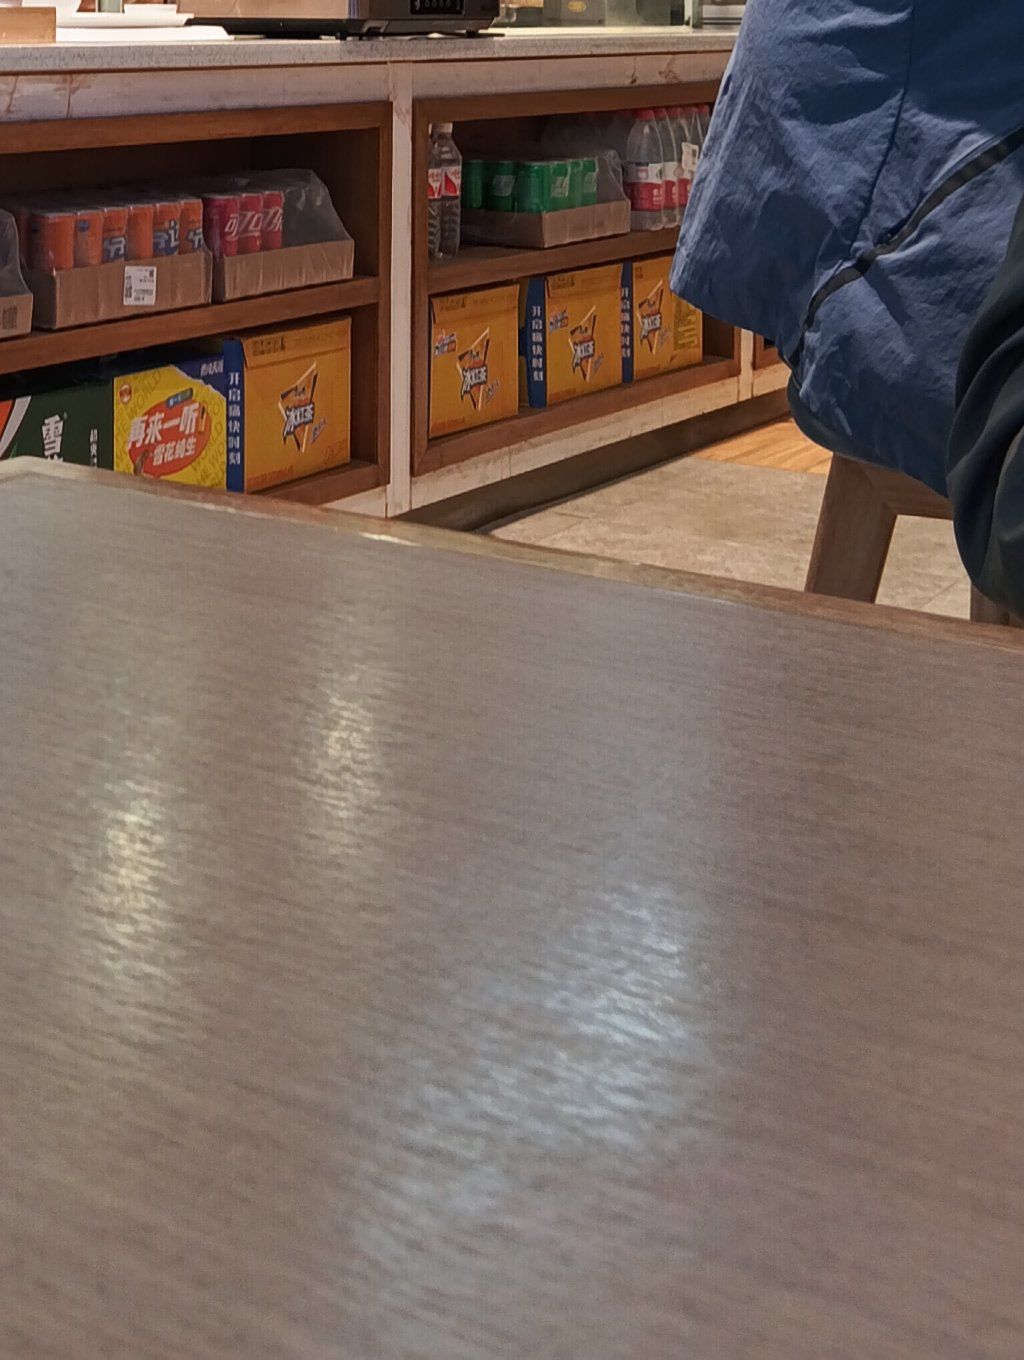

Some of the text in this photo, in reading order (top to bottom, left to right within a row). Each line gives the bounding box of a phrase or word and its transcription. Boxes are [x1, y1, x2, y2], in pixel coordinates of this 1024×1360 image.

[128, 401, 200, 448] 再来一听
[227, 371, 241, 466] 开启痛快时刻
